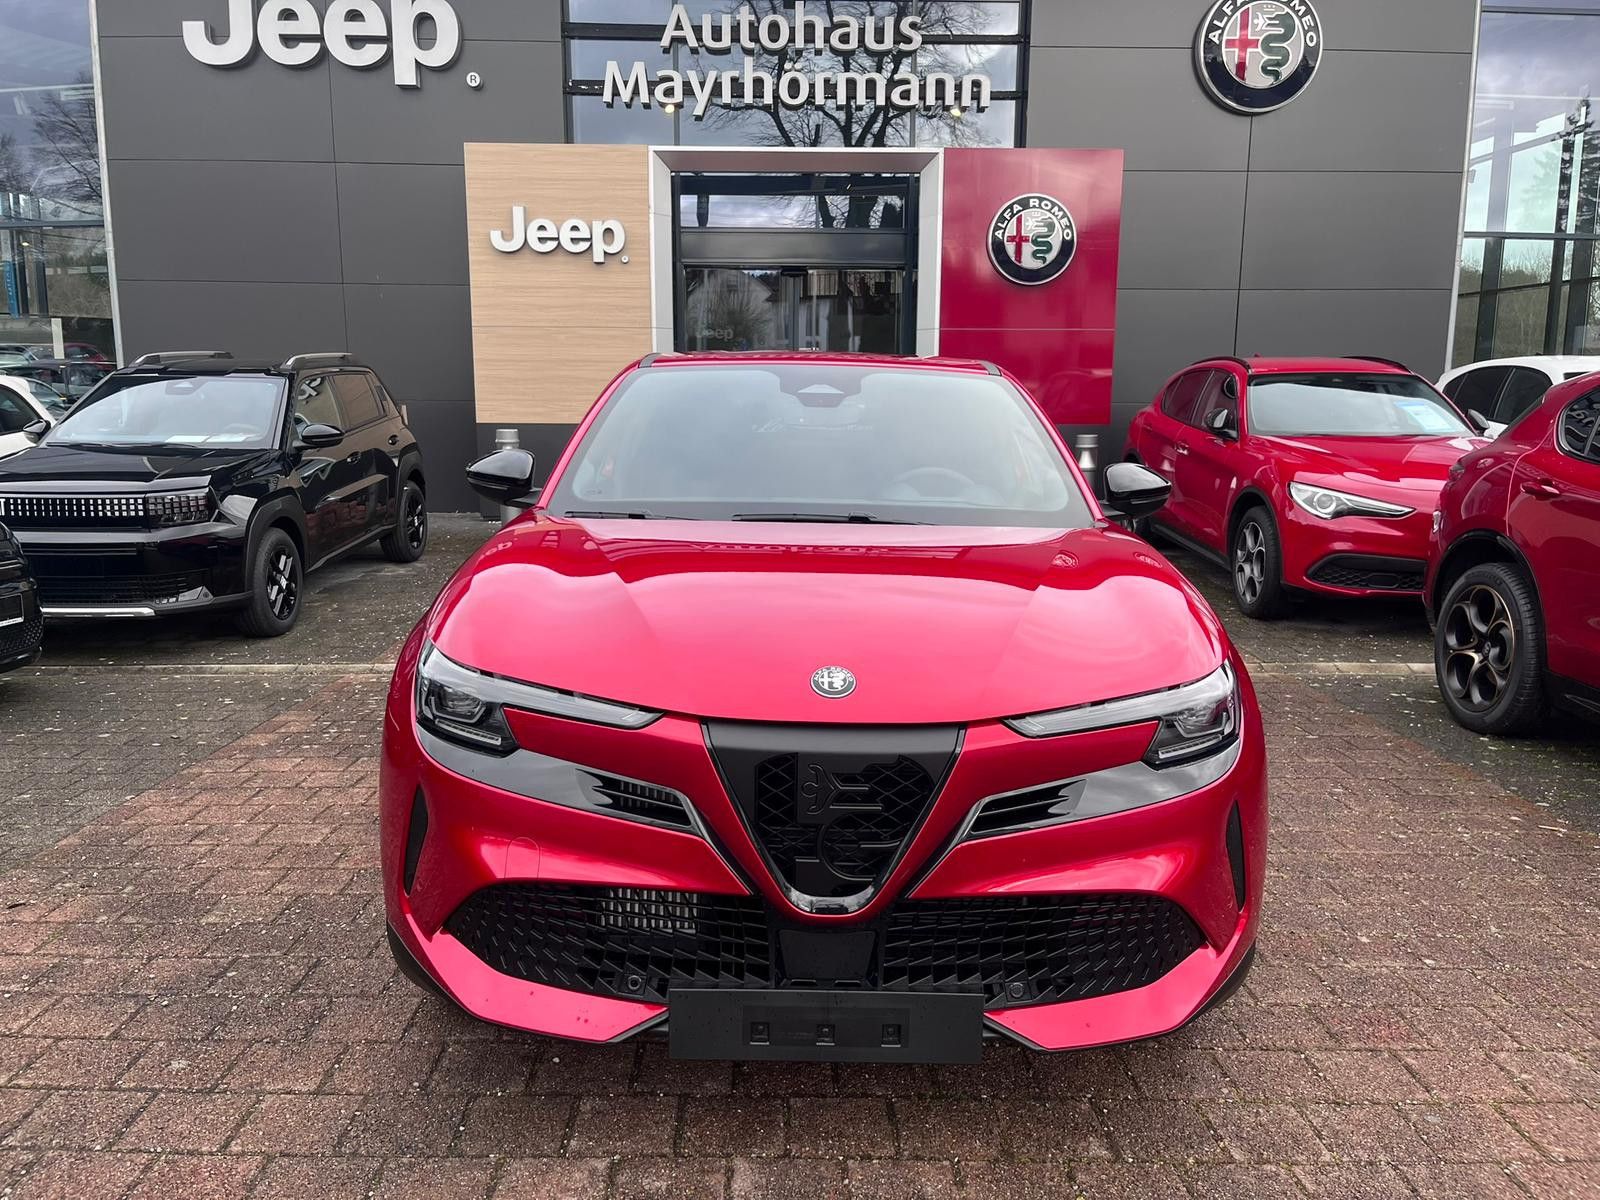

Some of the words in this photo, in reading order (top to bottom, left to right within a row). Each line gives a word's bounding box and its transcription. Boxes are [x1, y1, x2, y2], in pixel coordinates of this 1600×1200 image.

[182, 0, 462, 87] Jeep
[660, 1, 922, 52] Autohaus
[602, 57, 991, 115] Mayrhörmann
[490, 206, 626, 263] Jeep
[994, 203, 1023, 240] ALFA
[1029, 198, 1072, 240] ROMEO
